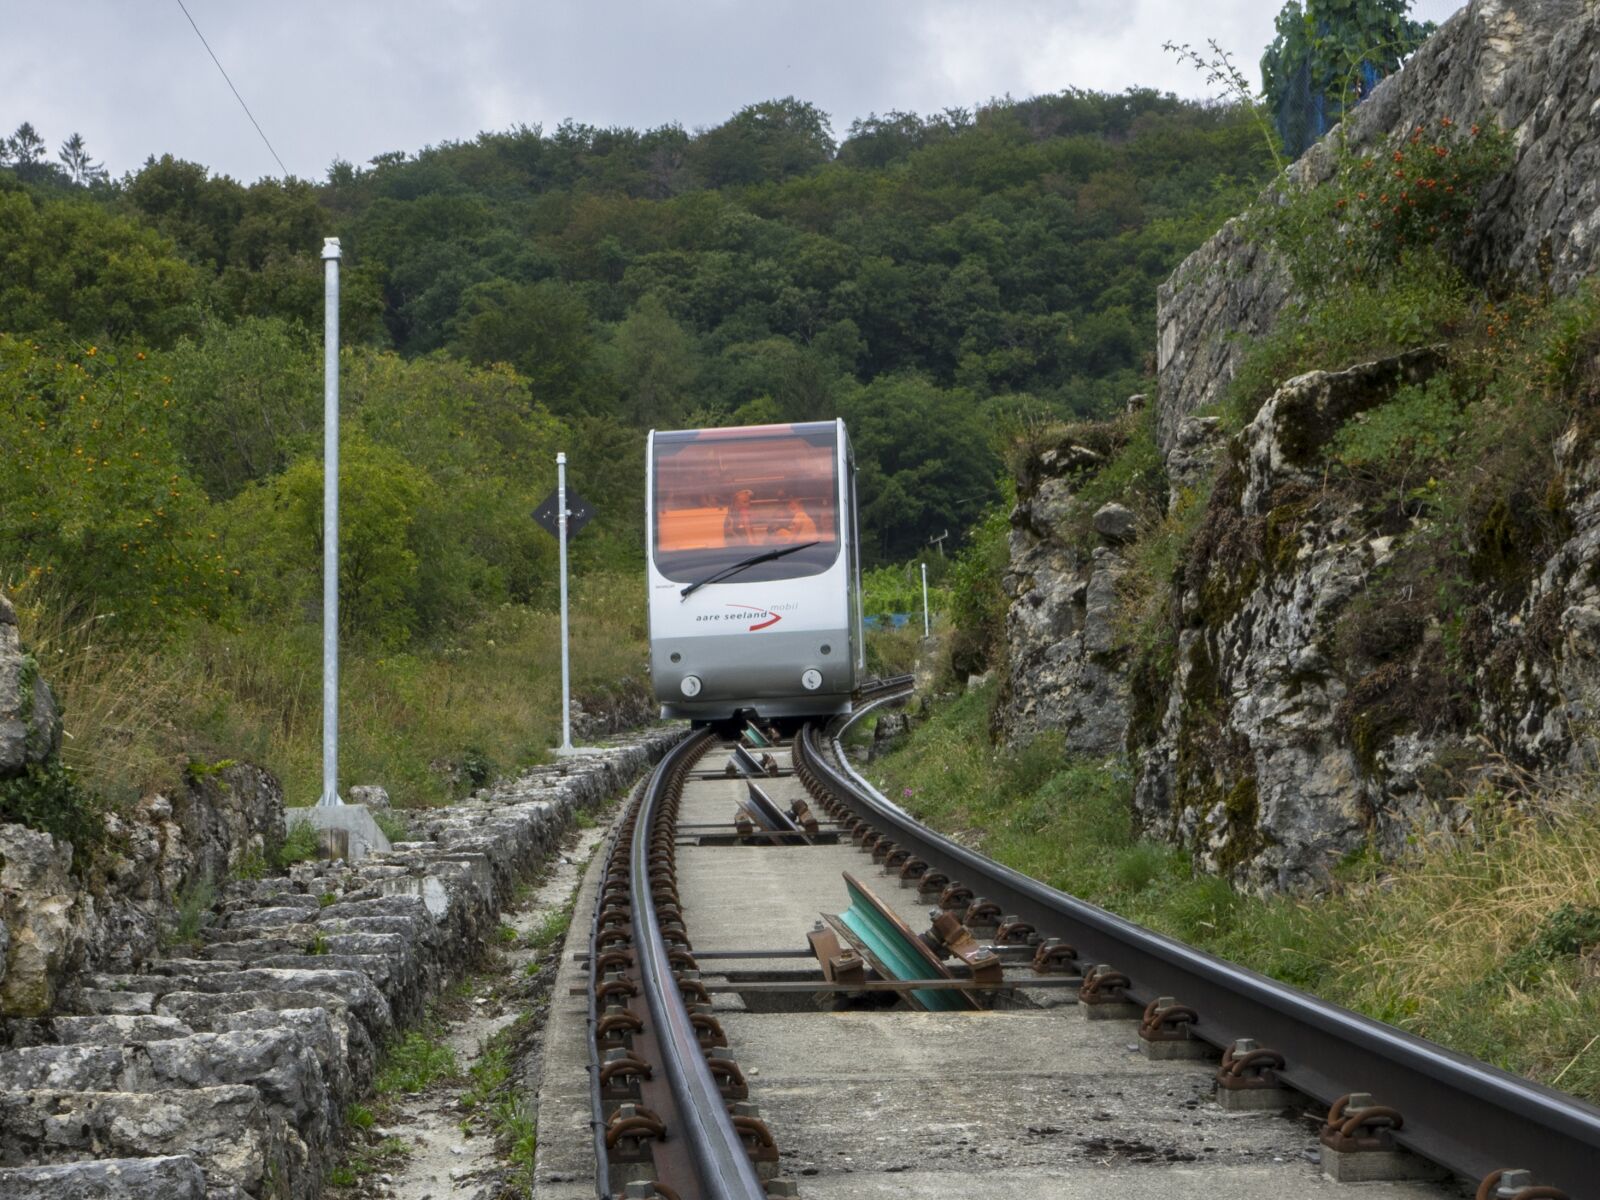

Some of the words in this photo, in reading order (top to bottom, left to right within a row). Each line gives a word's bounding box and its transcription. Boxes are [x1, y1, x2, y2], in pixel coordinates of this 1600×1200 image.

[770, 602, 799, 611] mobil
[696, 614, 720, 622] aare
[724, 610, 767, 621] seeland
